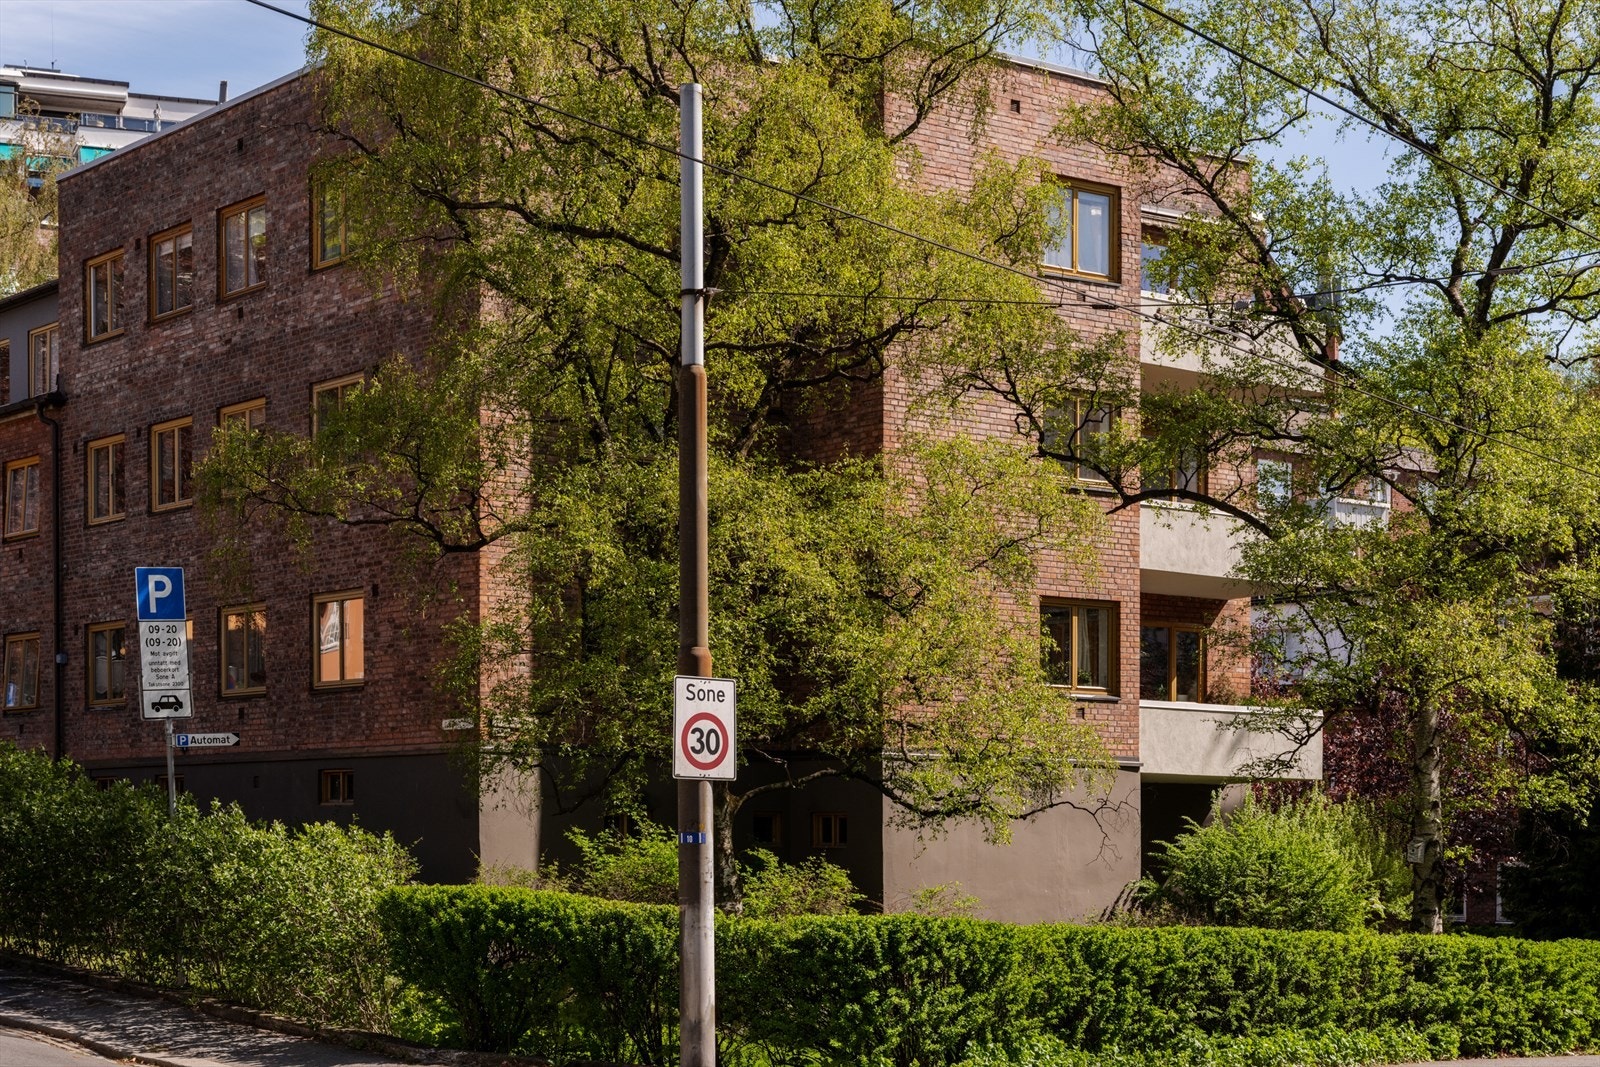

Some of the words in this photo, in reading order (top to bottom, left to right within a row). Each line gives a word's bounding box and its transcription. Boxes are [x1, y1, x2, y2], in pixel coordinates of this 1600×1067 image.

[147, 574, 172, 613] P
[686, 683, 726, 703] Sone
[190, 735, 230, 745] Automat
[690, 727, 720, 756] 30
